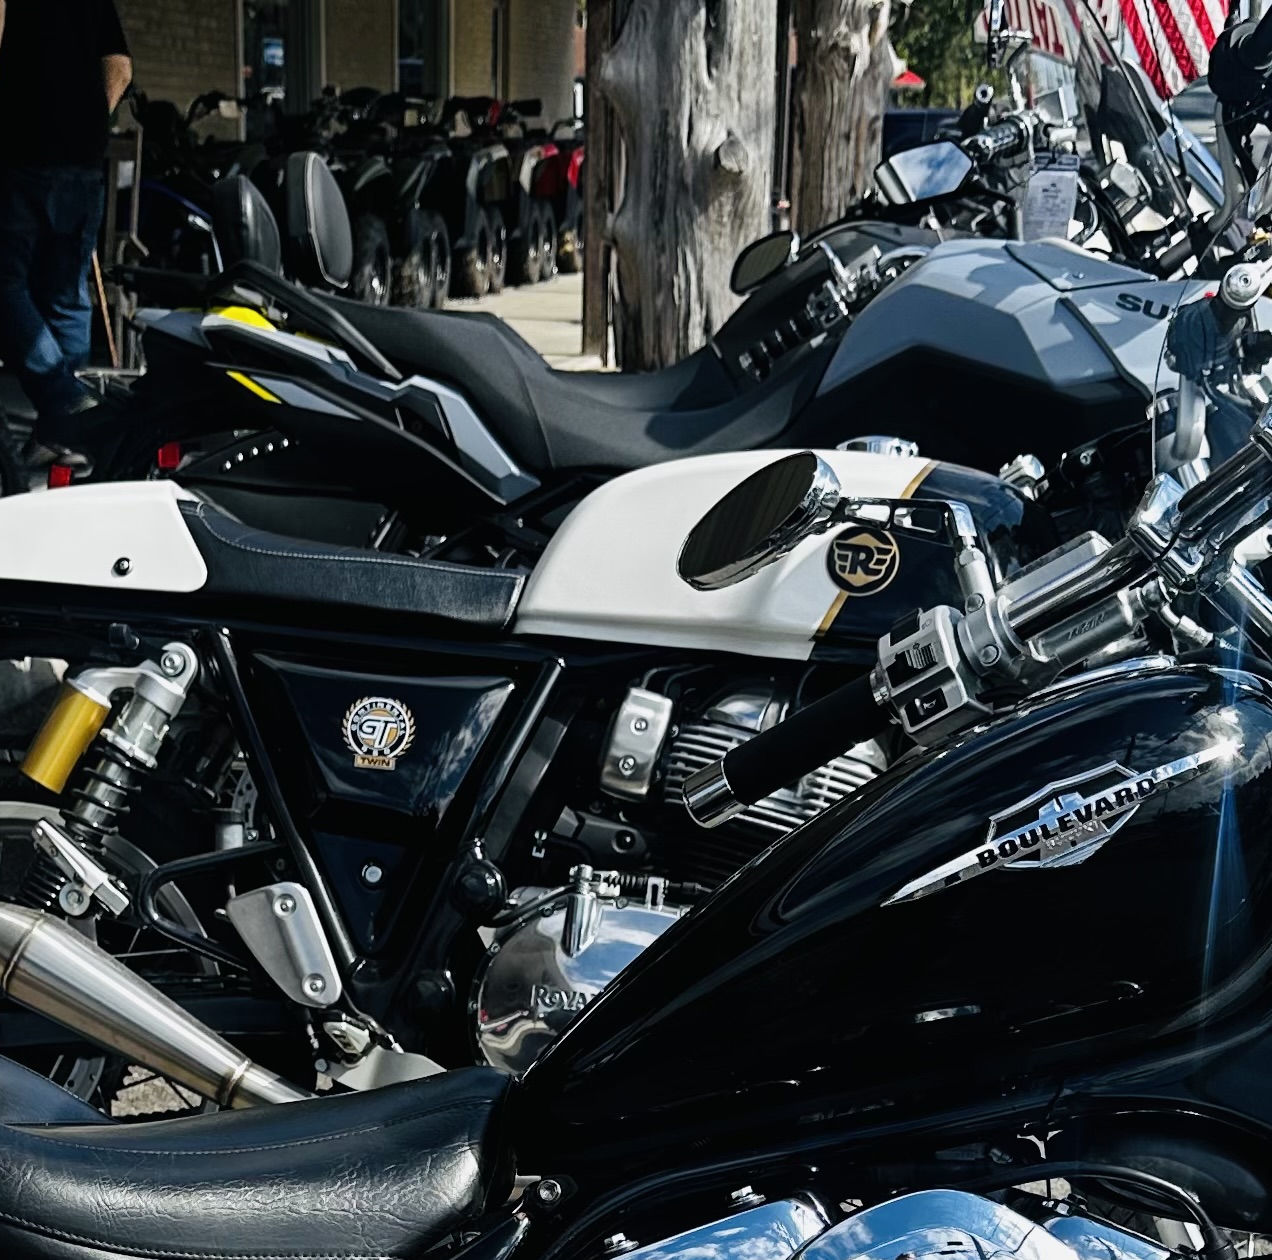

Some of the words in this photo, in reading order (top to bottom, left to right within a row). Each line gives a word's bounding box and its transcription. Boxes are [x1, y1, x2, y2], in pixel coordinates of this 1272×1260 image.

[359, 715, 397, 748] GT
[360, 757, 390, 767] TWIN
[976, 777, 1156, 869] BOULEVARD
[531, 985, 596, 1010] ROYA
